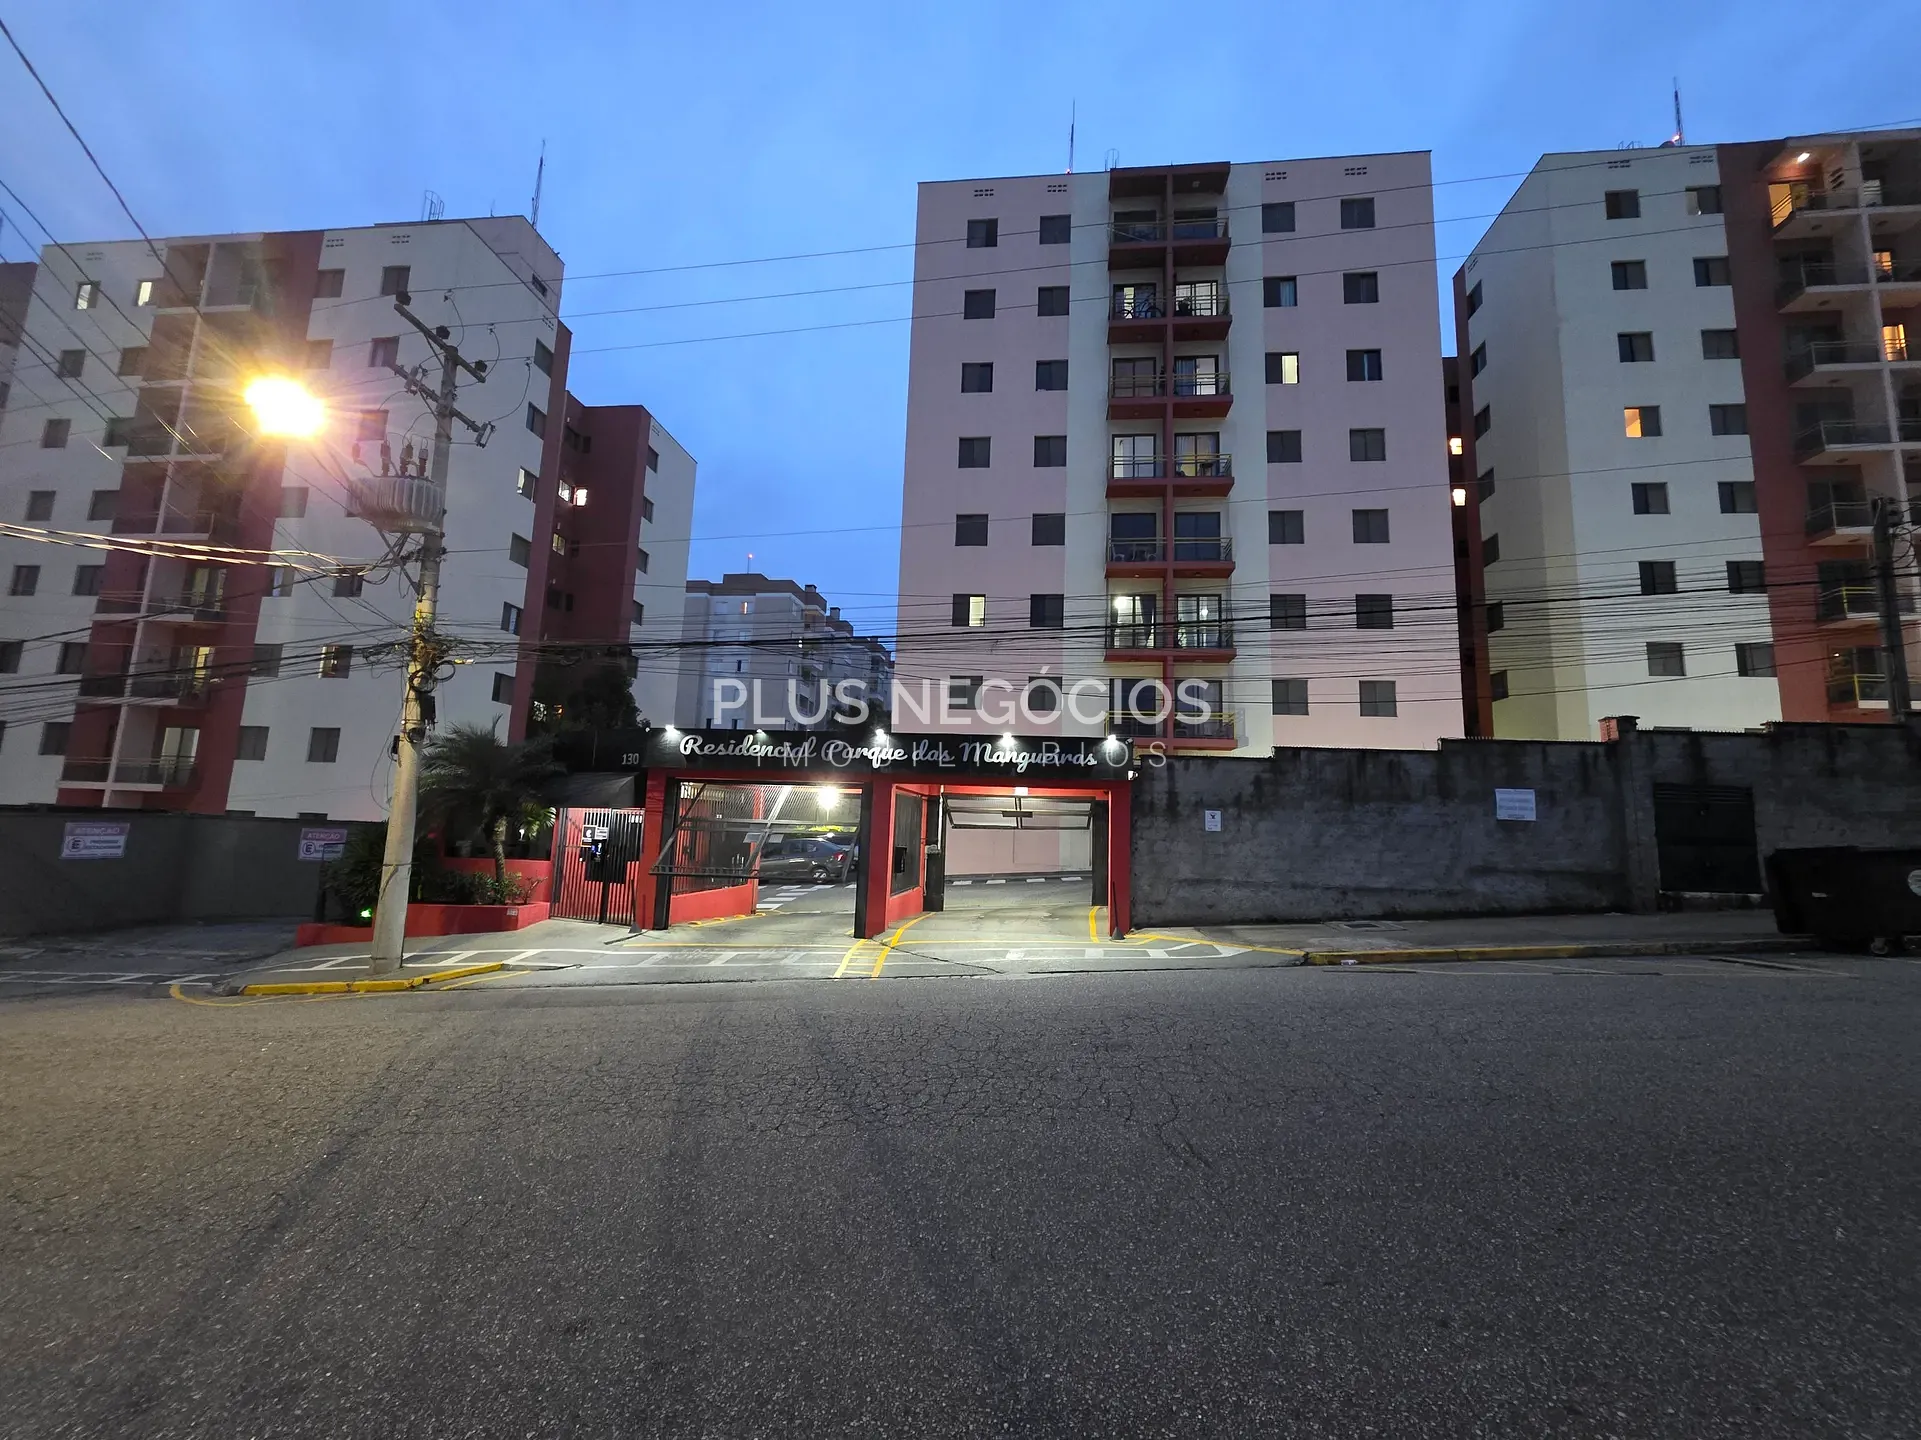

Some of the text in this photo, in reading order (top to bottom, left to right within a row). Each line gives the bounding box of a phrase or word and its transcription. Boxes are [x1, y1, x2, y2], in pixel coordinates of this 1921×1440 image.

[621, 752, 640, 765] 130
[679, 734, 1098, 773] Residencial Parque das Mangueiras
